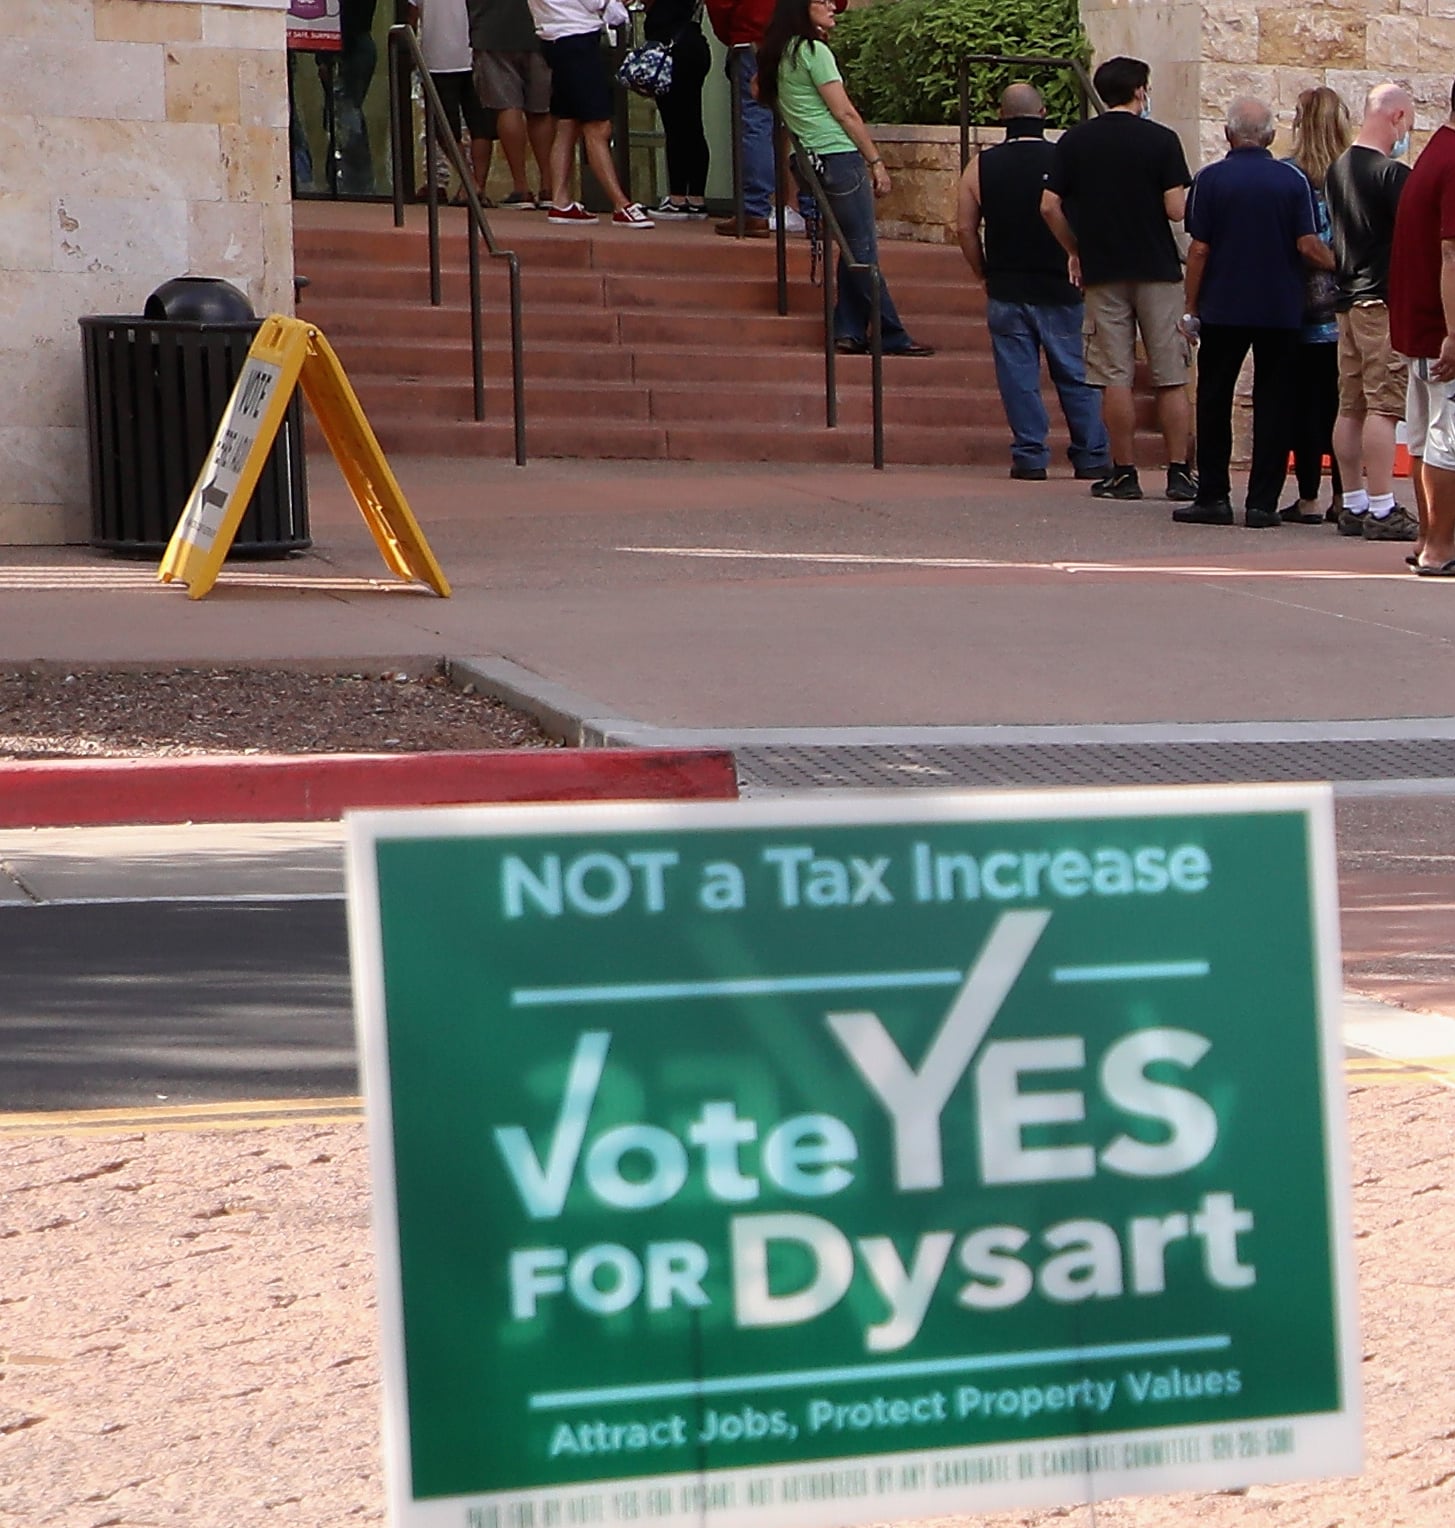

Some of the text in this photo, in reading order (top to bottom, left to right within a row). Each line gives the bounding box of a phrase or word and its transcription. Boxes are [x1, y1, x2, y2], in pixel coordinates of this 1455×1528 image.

[500, 840, 1212, 920] NOT a Tax Increase
[492, 909, 1222, 1219] Vote YES
[510, 1192, 1256, 1353] FOR Dysart
[550, 1366, 1243, 1459] Attract Jobs, Protect Property Values
